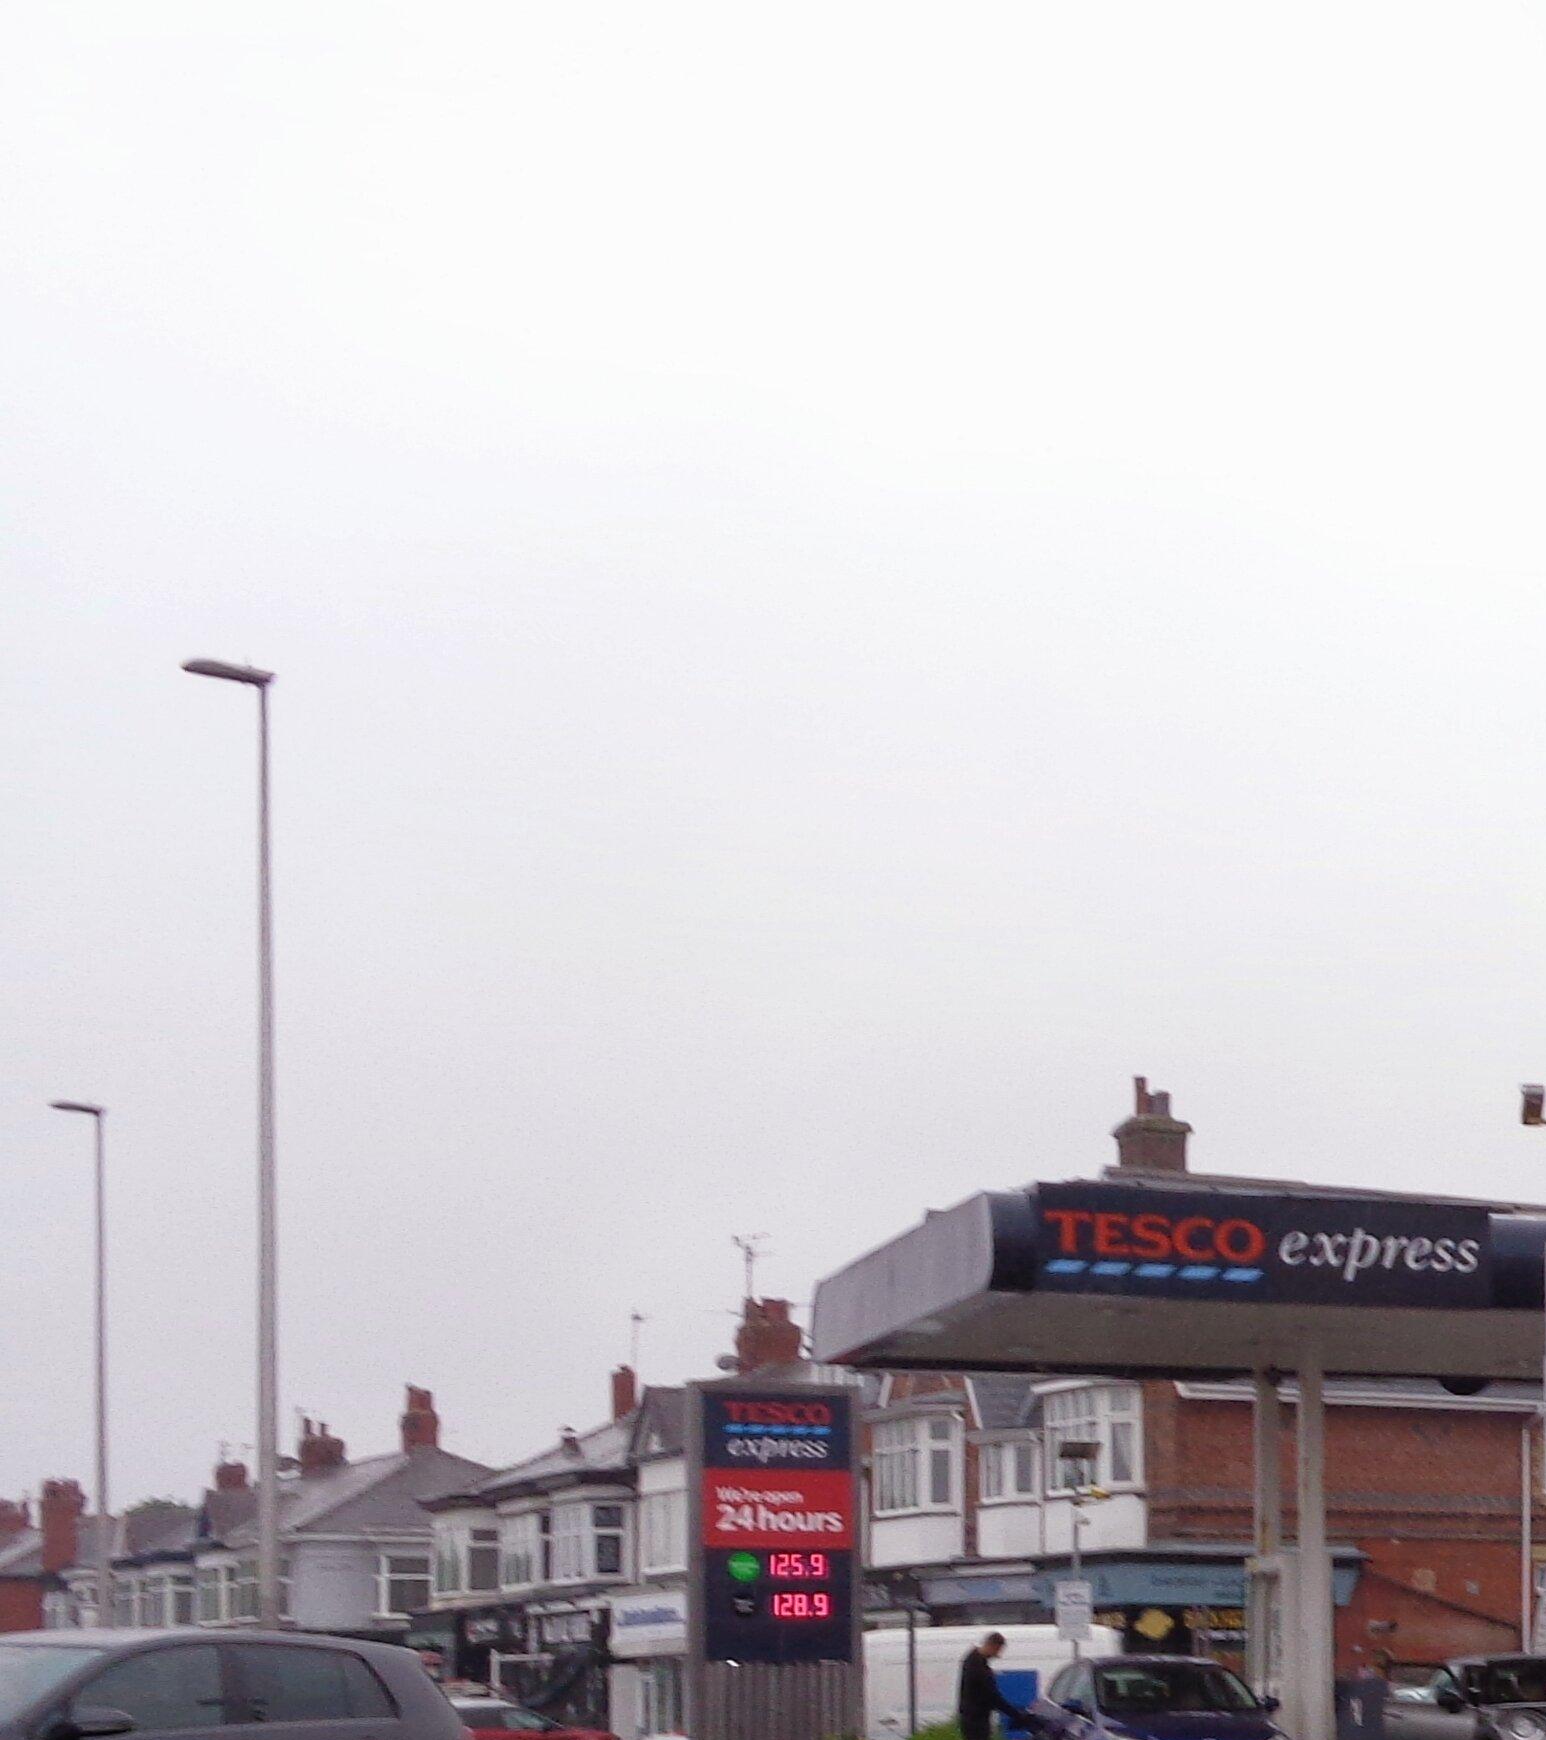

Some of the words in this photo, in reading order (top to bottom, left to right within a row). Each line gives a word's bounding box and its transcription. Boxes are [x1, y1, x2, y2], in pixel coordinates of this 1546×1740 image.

[1043, 1208, 1267, 1263] TESCO
[1278, 1227, 1480, 1282] express
[722, 1401, 832, 1424] TESCO
[726, 1436, 830, 1463] express
[715, 1503, 754, 1532] 24
[756, 1504, 845, 1533] hours
[769, 1553, 824, 1577] 125.9
[773, 1593, 829, 1617] 128.9
